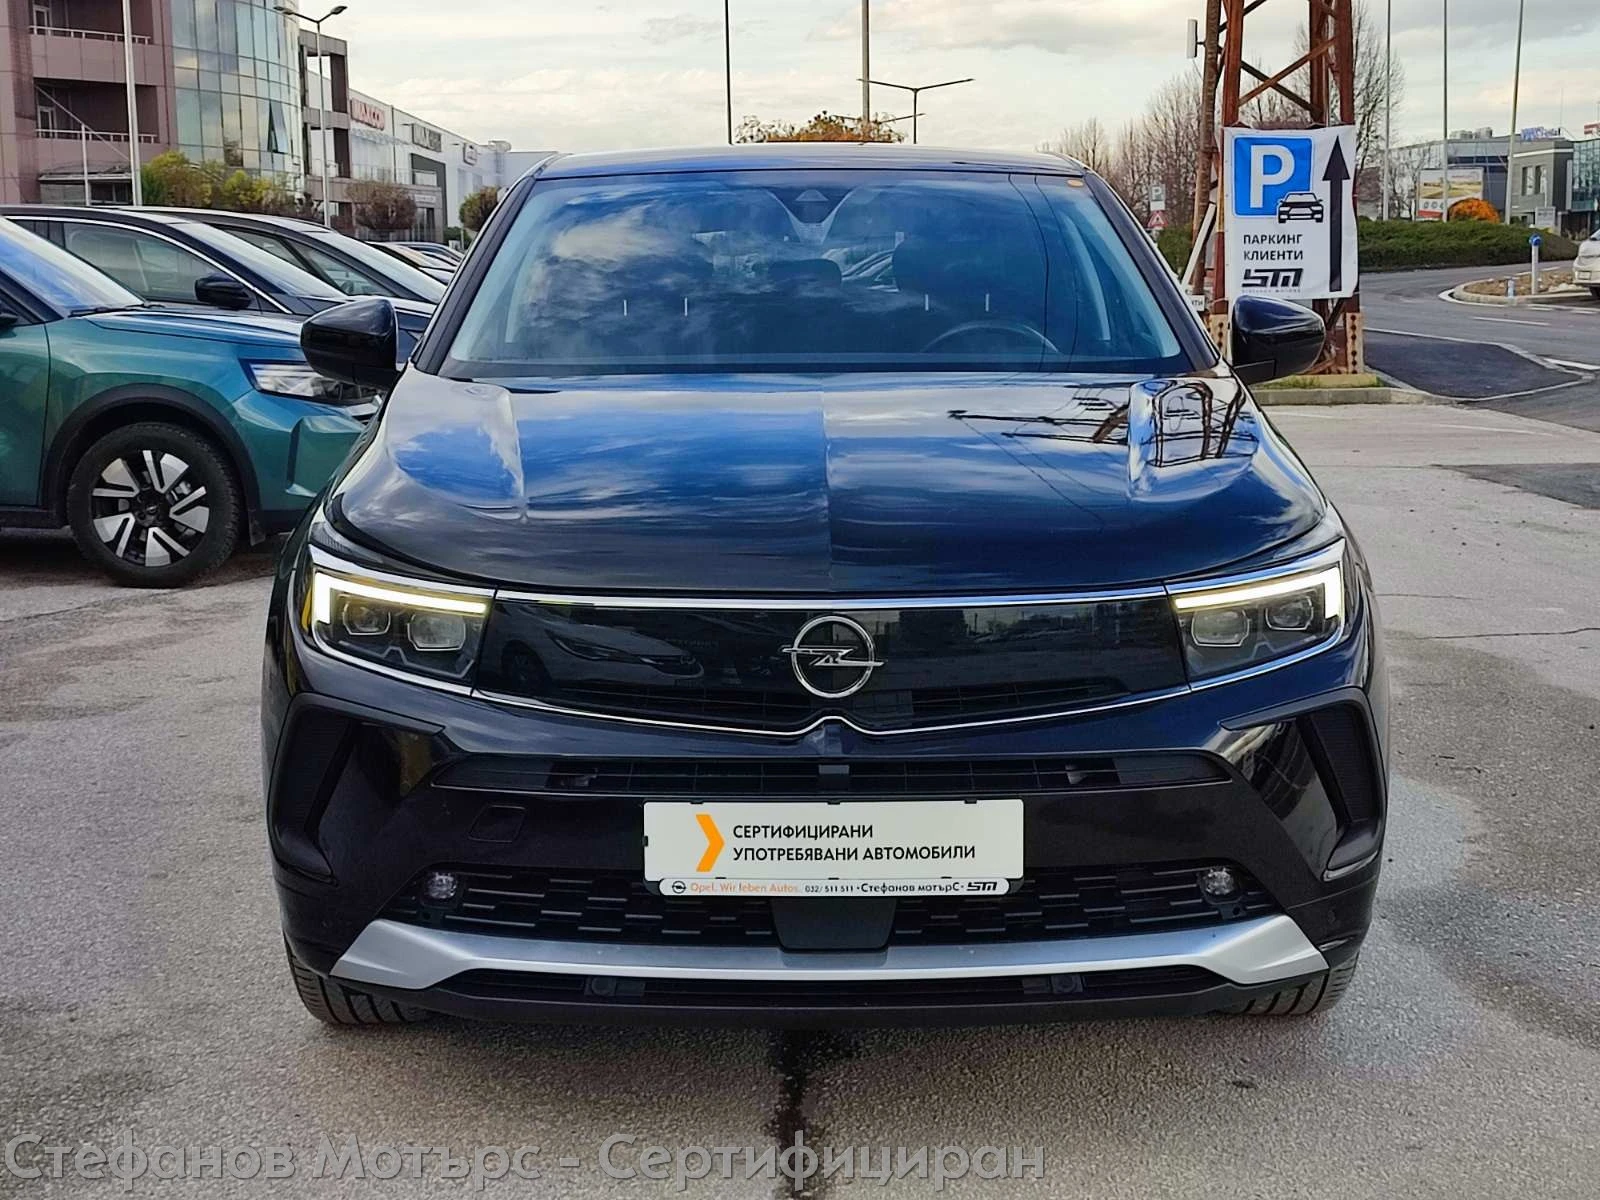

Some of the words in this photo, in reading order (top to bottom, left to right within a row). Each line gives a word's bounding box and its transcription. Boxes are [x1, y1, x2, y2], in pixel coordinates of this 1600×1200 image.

[1250, 144, 1295, 208] P
[1243, 234, 1303, 245] ПАРКИНГ
[1243, 250, 1303, 261] КЛИЕНТИ
[733, 825, 873, 840] СЕРТИФИЦИРАНИ
[733, 847, 858, 861] УПОТРЕБЯВАНИ
[862, 845, 976, 860] АВТОМОБИЛИ
